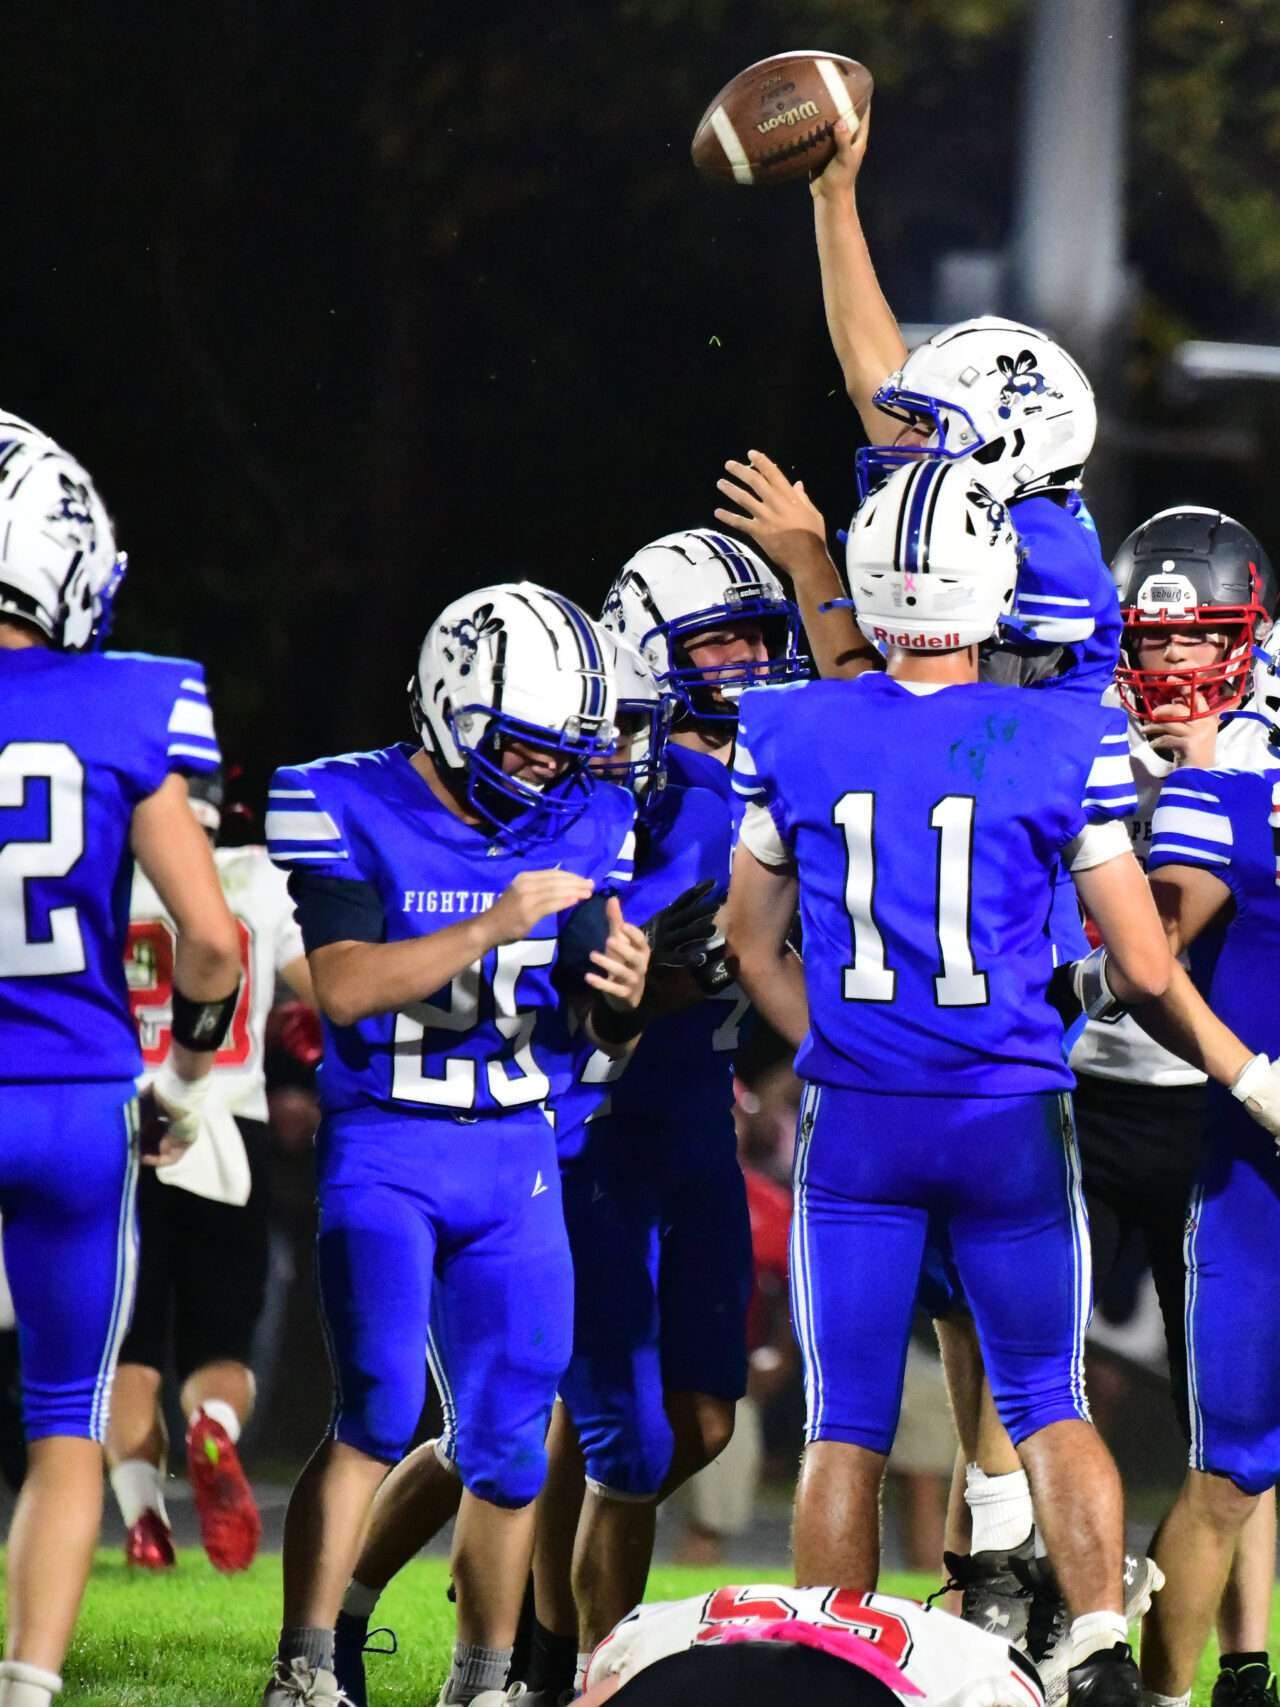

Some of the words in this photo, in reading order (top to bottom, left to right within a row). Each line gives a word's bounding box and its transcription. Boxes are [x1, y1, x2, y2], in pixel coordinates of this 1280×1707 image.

[757, 101, 820, 134] Wilson
[873, 626, 960, 648] Riddell
[403, 890, 503, 913] FIGHTIN
[831, 790, 990, 1008] 11
[391, 936, 558, 1109] 25
